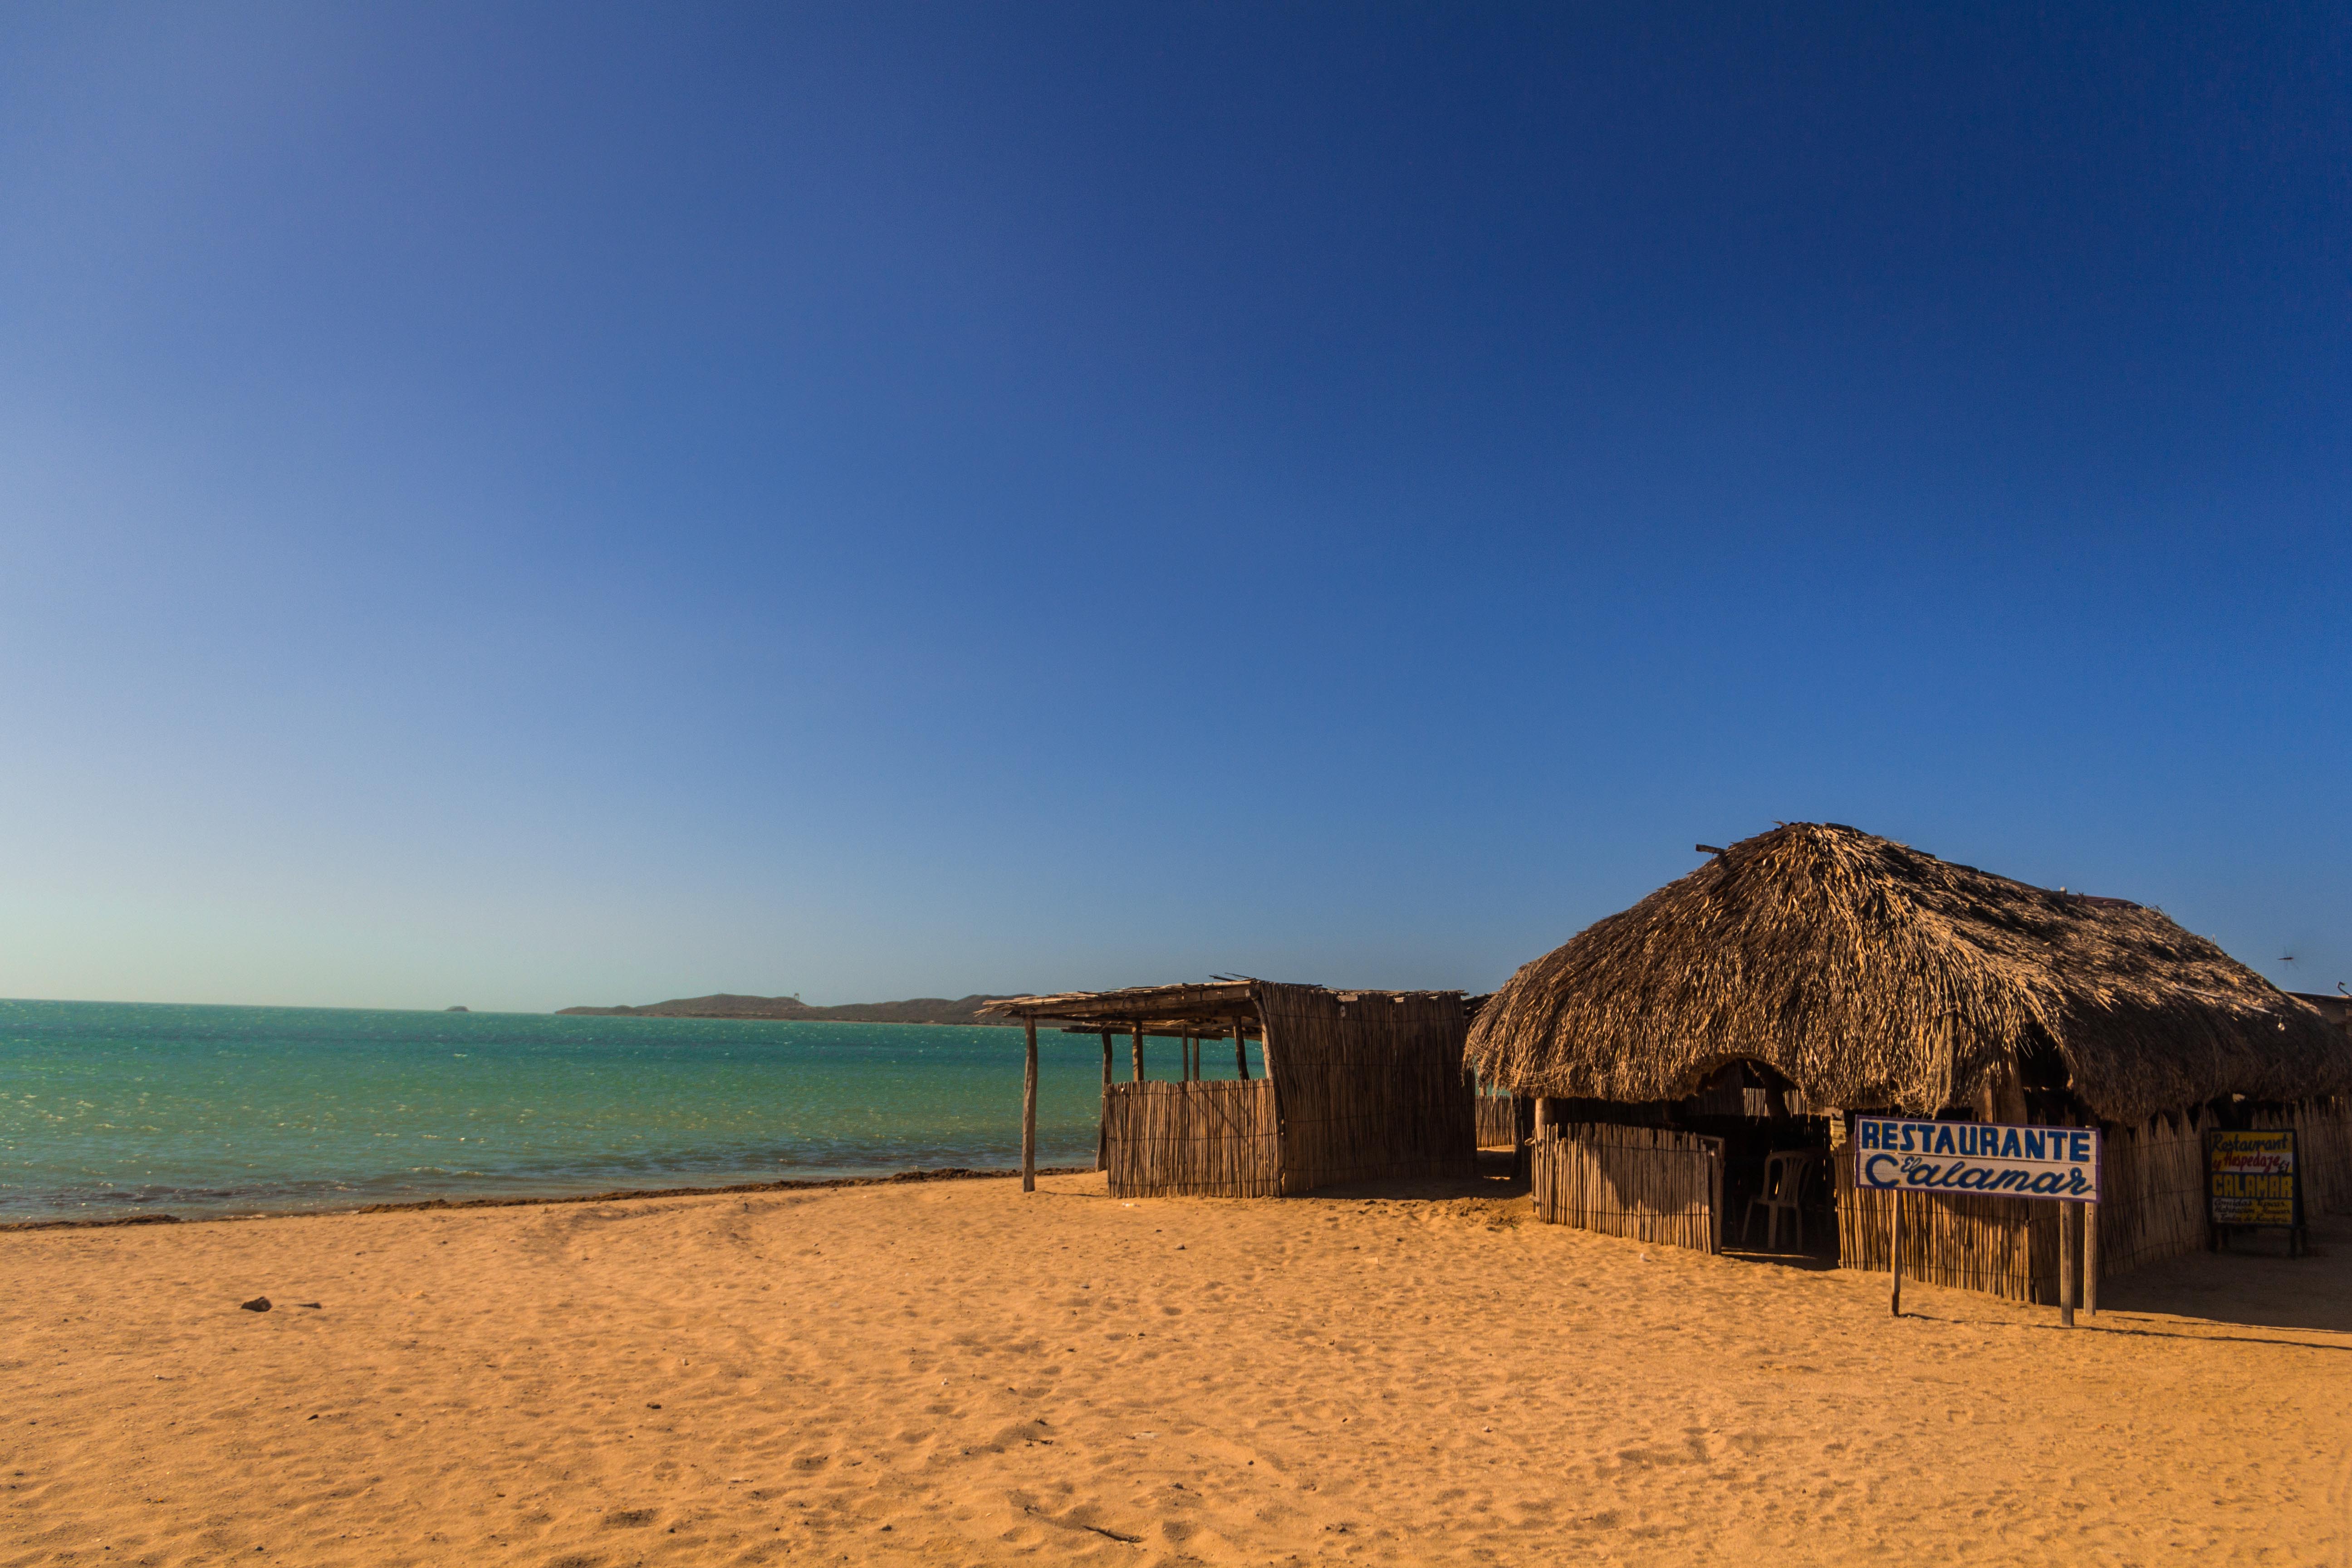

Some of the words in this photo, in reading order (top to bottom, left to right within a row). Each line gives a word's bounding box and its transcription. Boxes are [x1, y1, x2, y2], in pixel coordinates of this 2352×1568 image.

[1862, 1121, 2090, 1162] RESTAURANTE
[2211, 1133, 2288, 1152] Restaurant
[2224, 1151, 2280, 1173] Hospedaje
[1865, 1153, 2093, 1196] Calamar
[2212, 1174, 2293, 1198] CALAMAR
